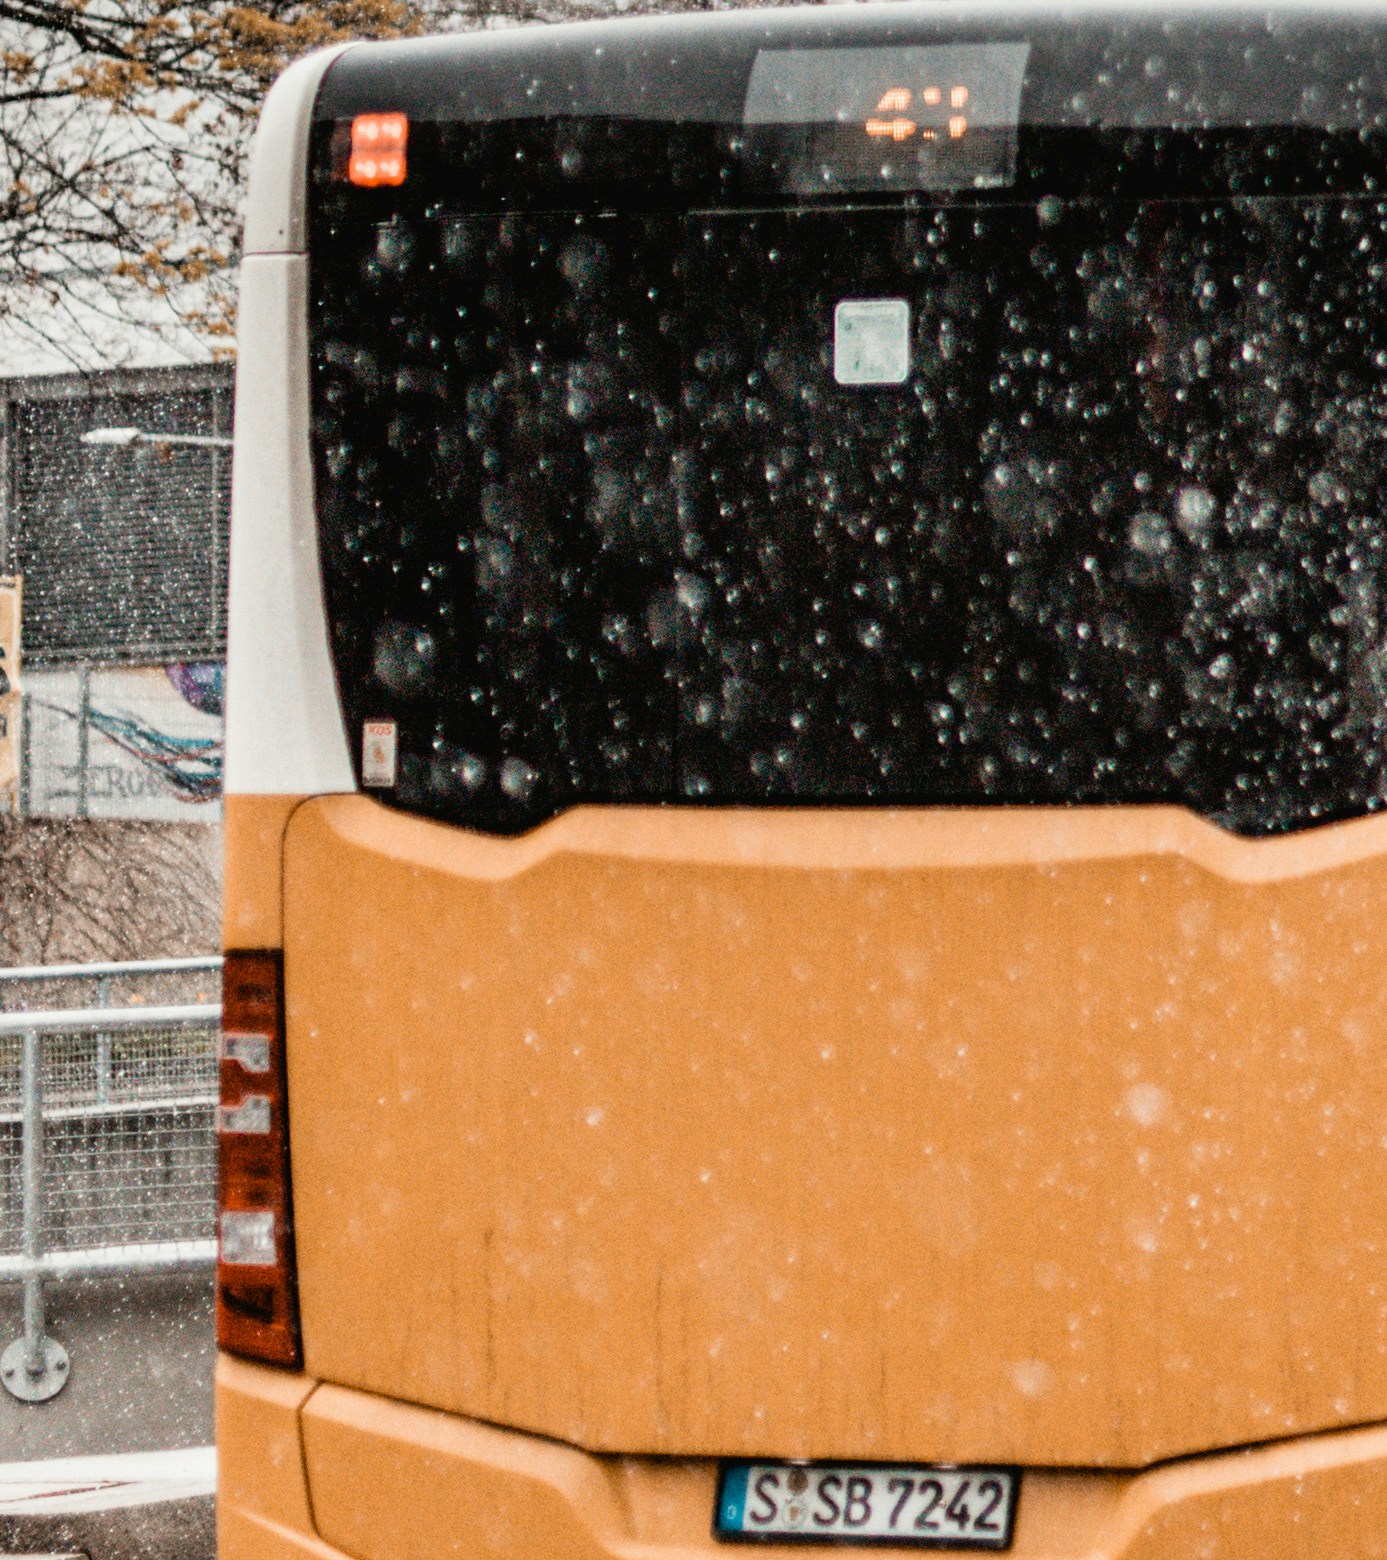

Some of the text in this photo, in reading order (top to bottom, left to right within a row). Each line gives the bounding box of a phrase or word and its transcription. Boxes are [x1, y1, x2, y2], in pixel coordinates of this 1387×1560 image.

[750, 1474, 1002, 1532] S SB 7242
